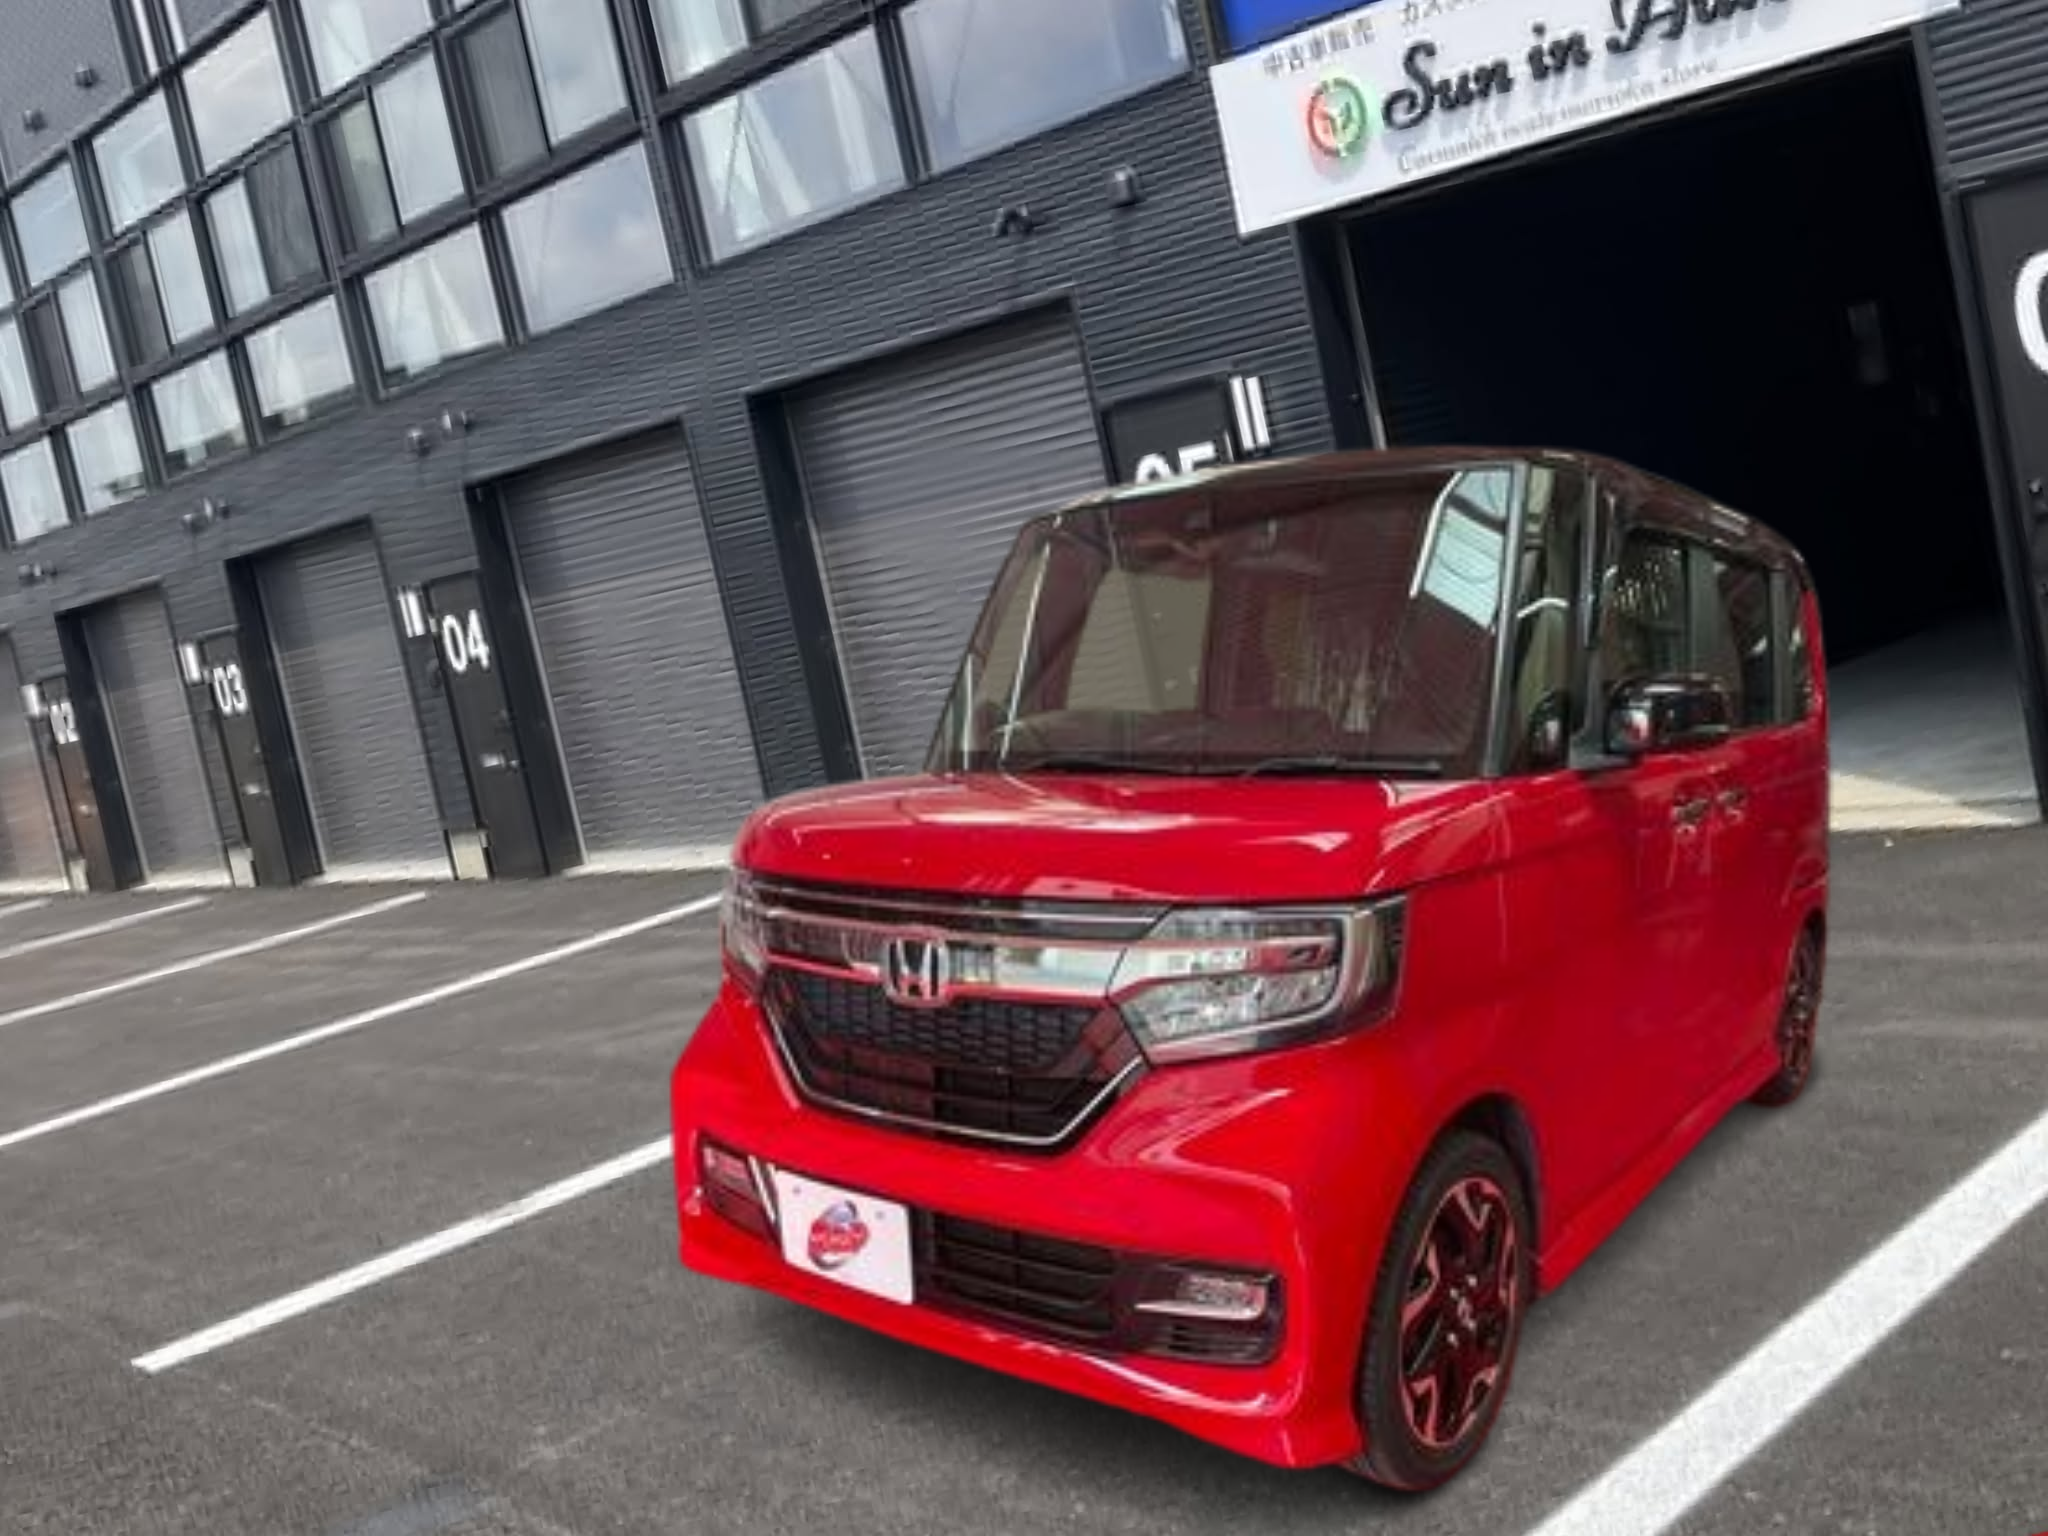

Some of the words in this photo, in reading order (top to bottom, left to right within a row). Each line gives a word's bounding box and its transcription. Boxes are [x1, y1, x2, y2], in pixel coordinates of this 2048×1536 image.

[1381, 41, 1516, 130] Sun
[1527, 22, 1593, 80] in
[441, 608, 490, 674] 04
[212, 662, 249, 716] 03
